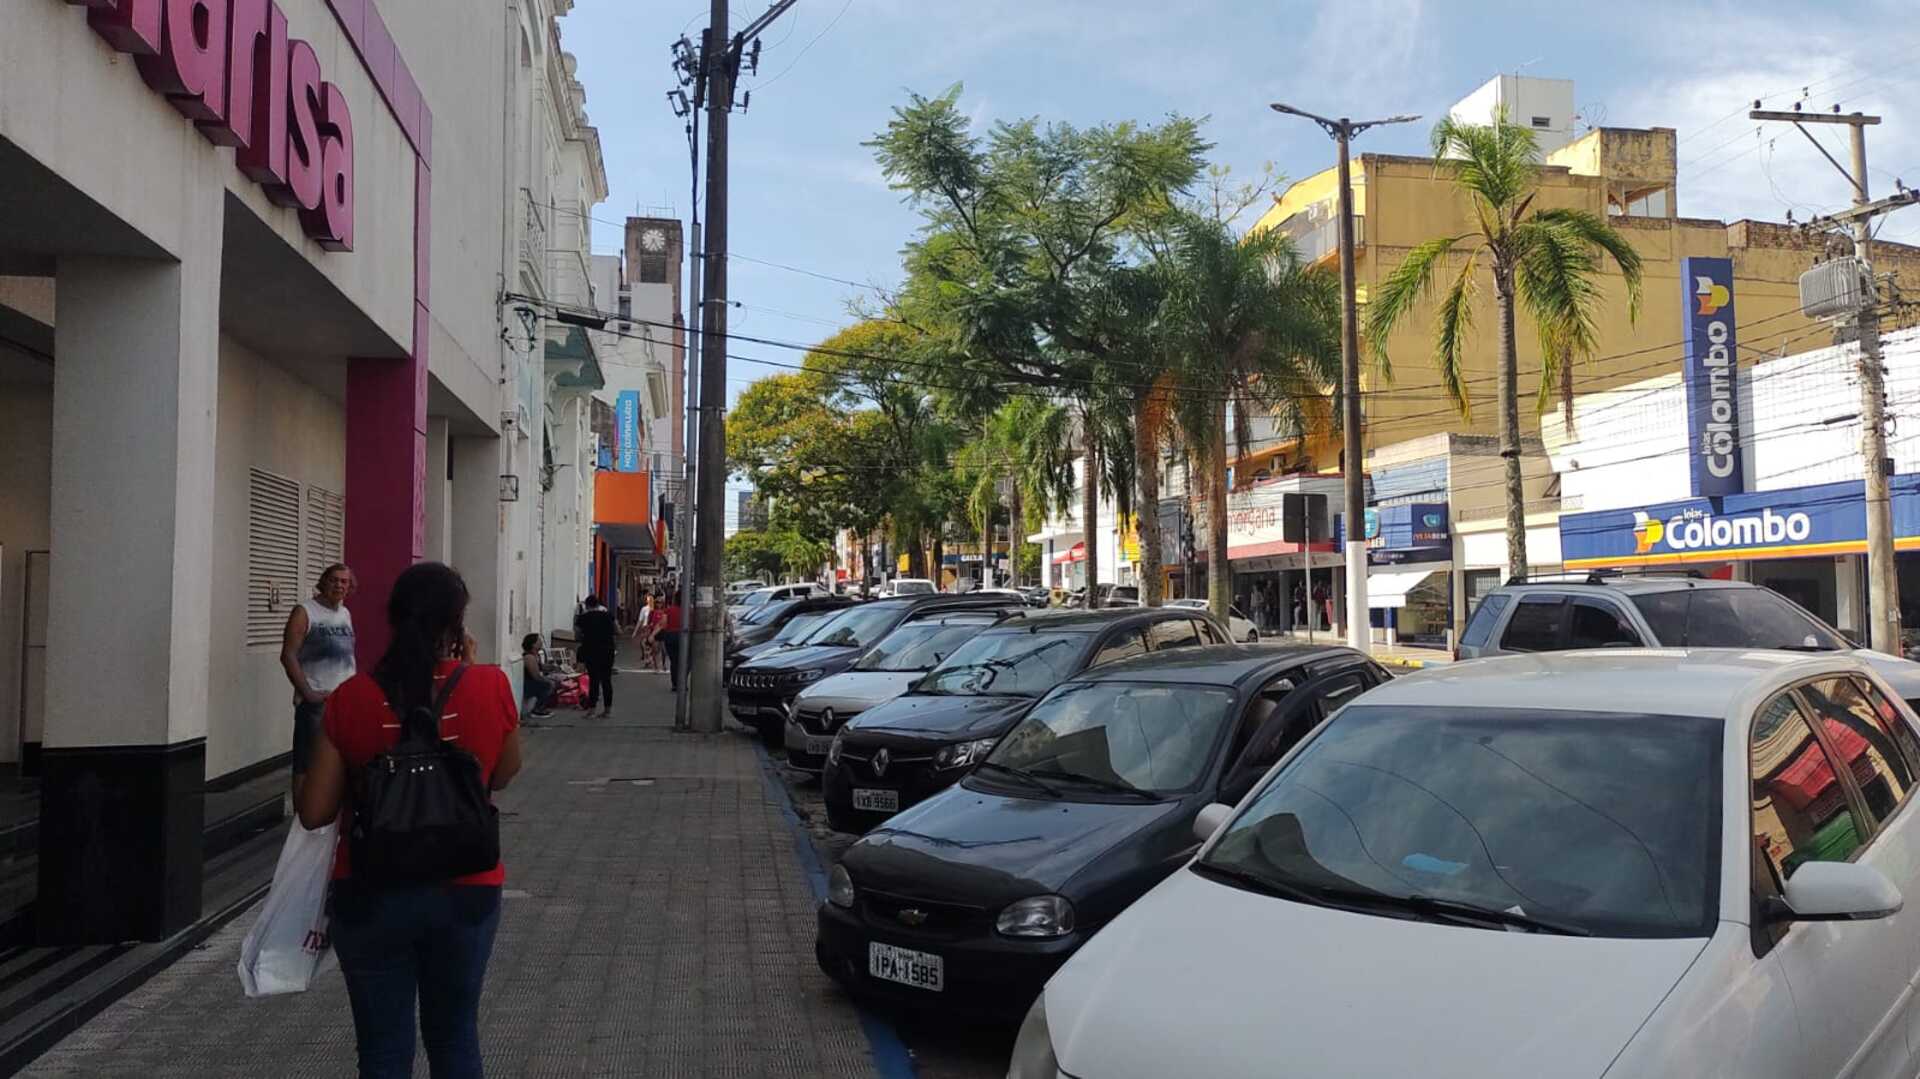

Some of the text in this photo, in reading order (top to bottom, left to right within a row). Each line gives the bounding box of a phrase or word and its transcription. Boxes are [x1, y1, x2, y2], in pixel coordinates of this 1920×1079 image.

[92, 0, 353, 252] arisa
[1703, 321, 1734, 478] Colombo
[1665, 508, 1811, 550] Colombo
